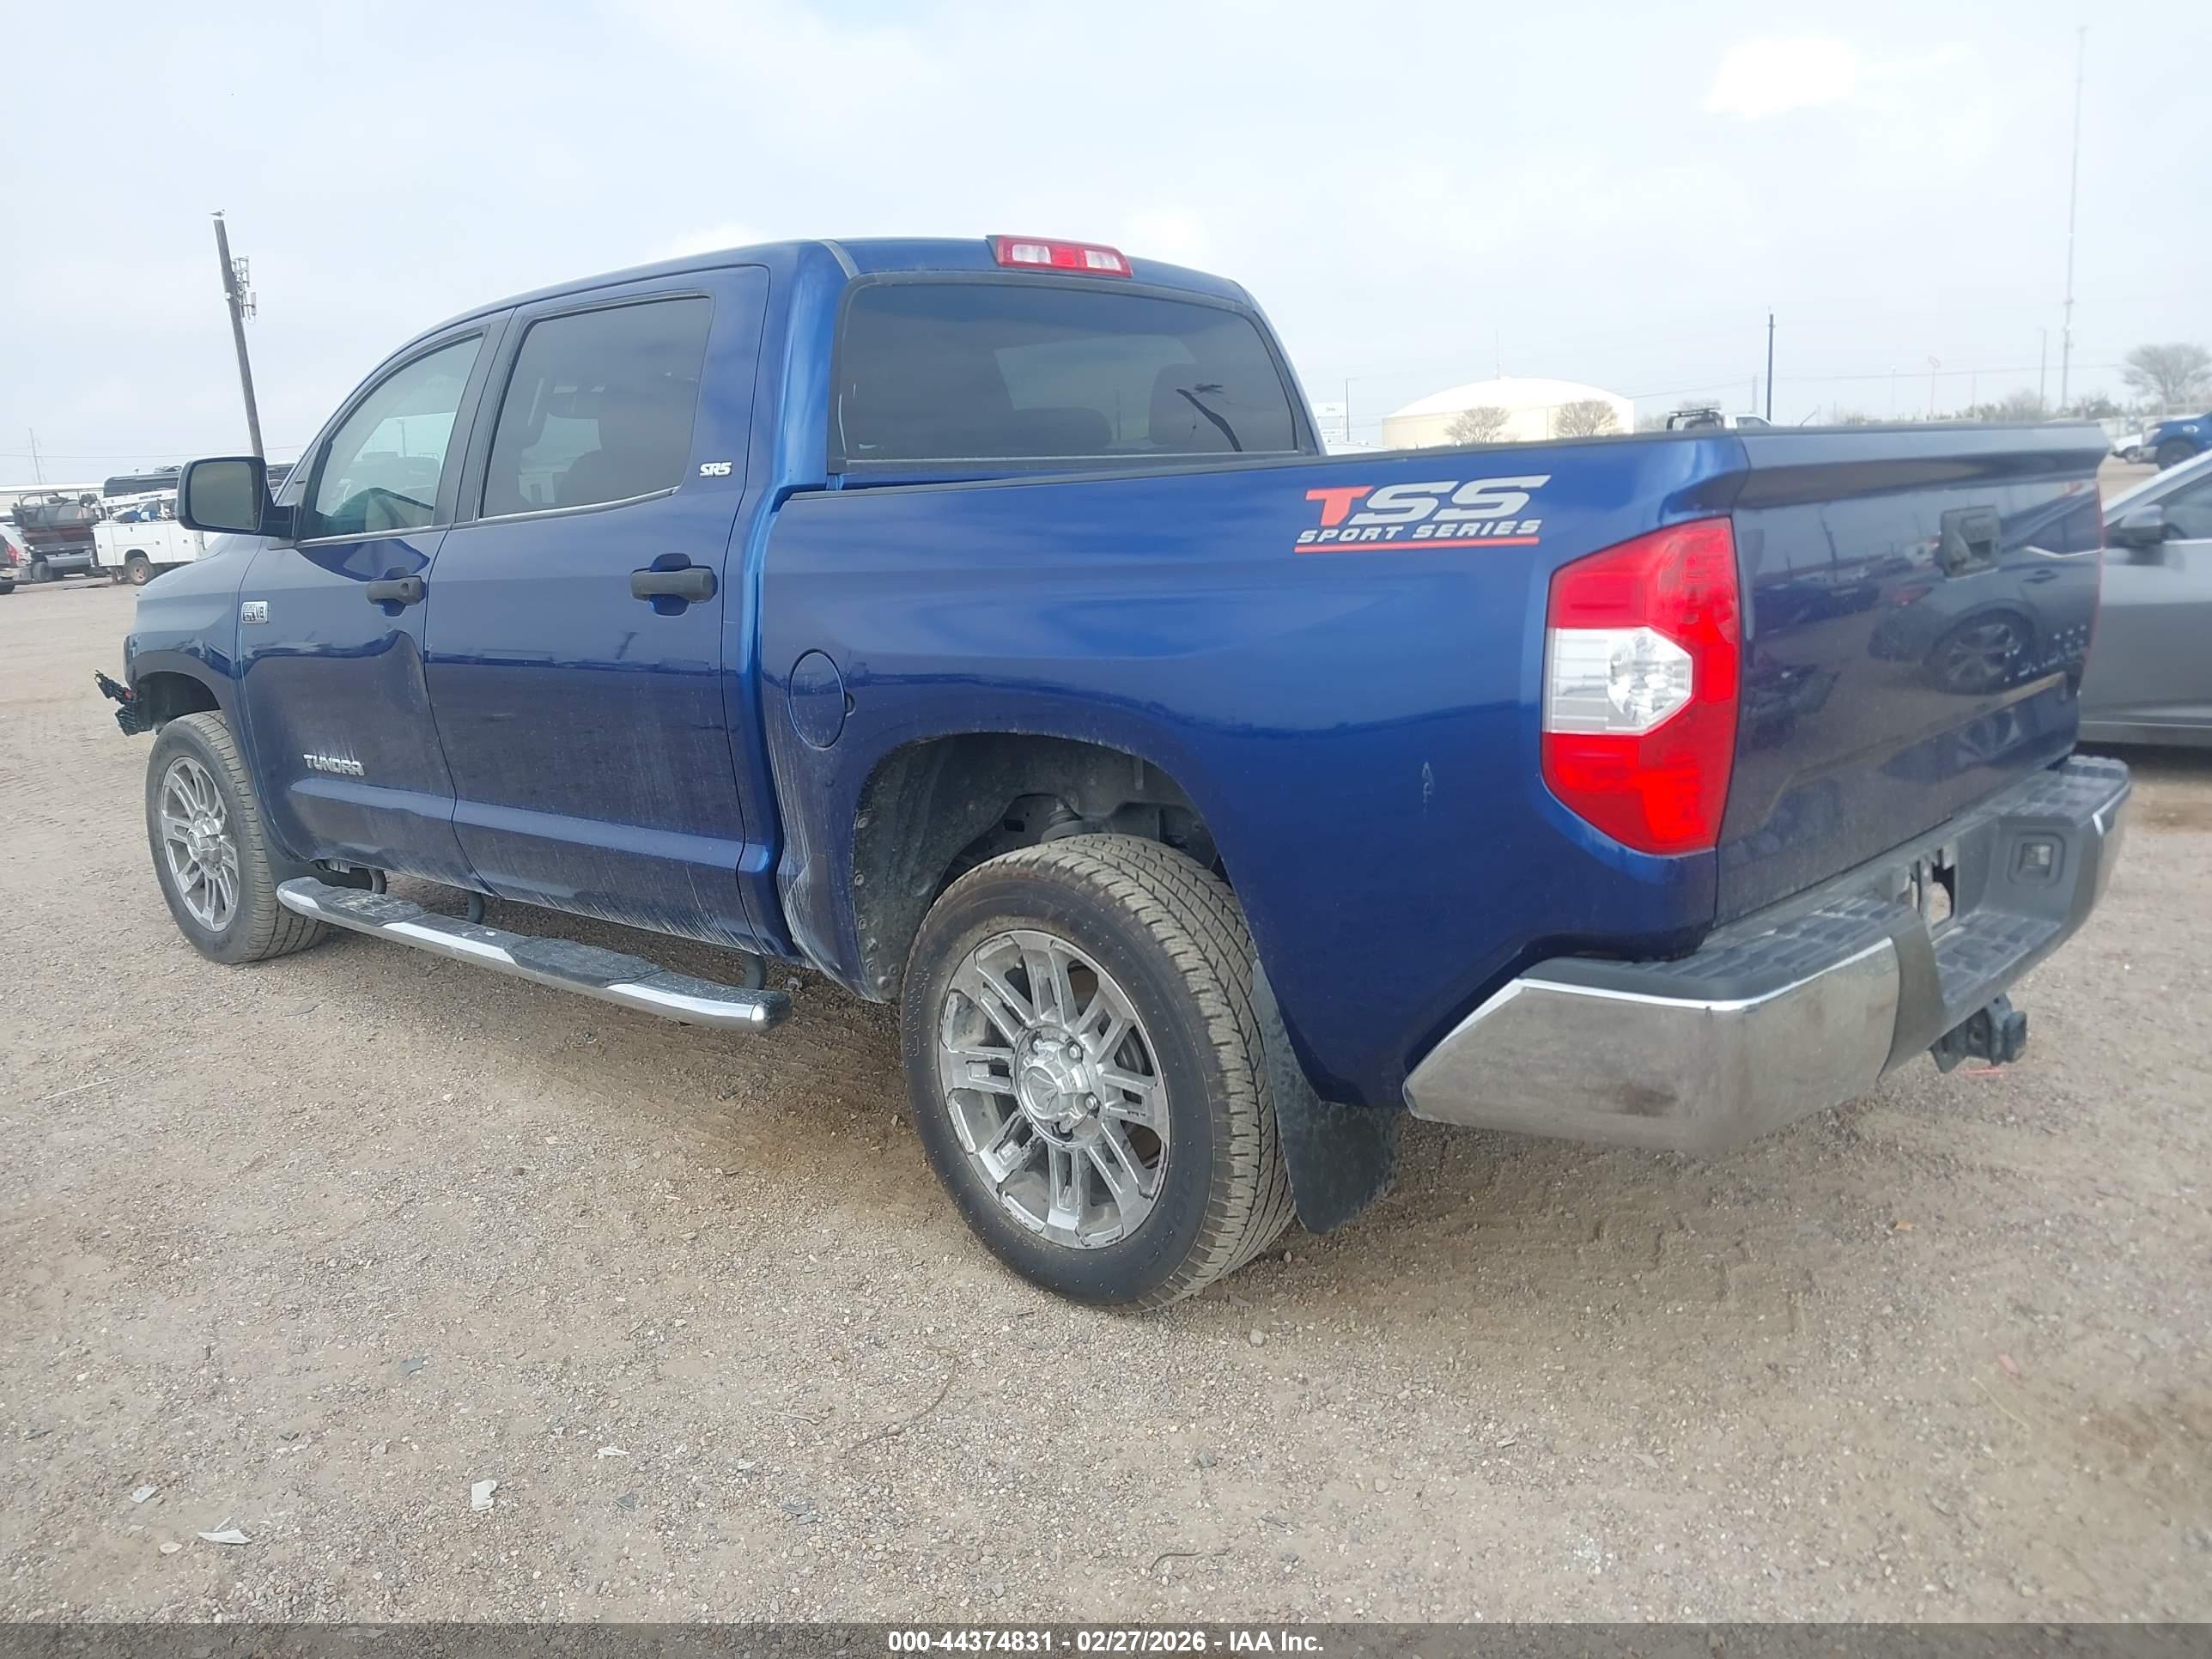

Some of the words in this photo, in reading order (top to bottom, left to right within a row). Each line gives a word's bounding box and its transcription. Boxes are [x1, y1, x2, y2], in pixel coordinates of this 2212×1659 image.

[700, 462, 732, 477] SR5
[1305, 475, 1552, 526] TSS
[1297, 526, 1404, 544] SPORT
[1412, 519, 1542, 539] SERIES
[303, 754, 365, 776] TUNDRA
